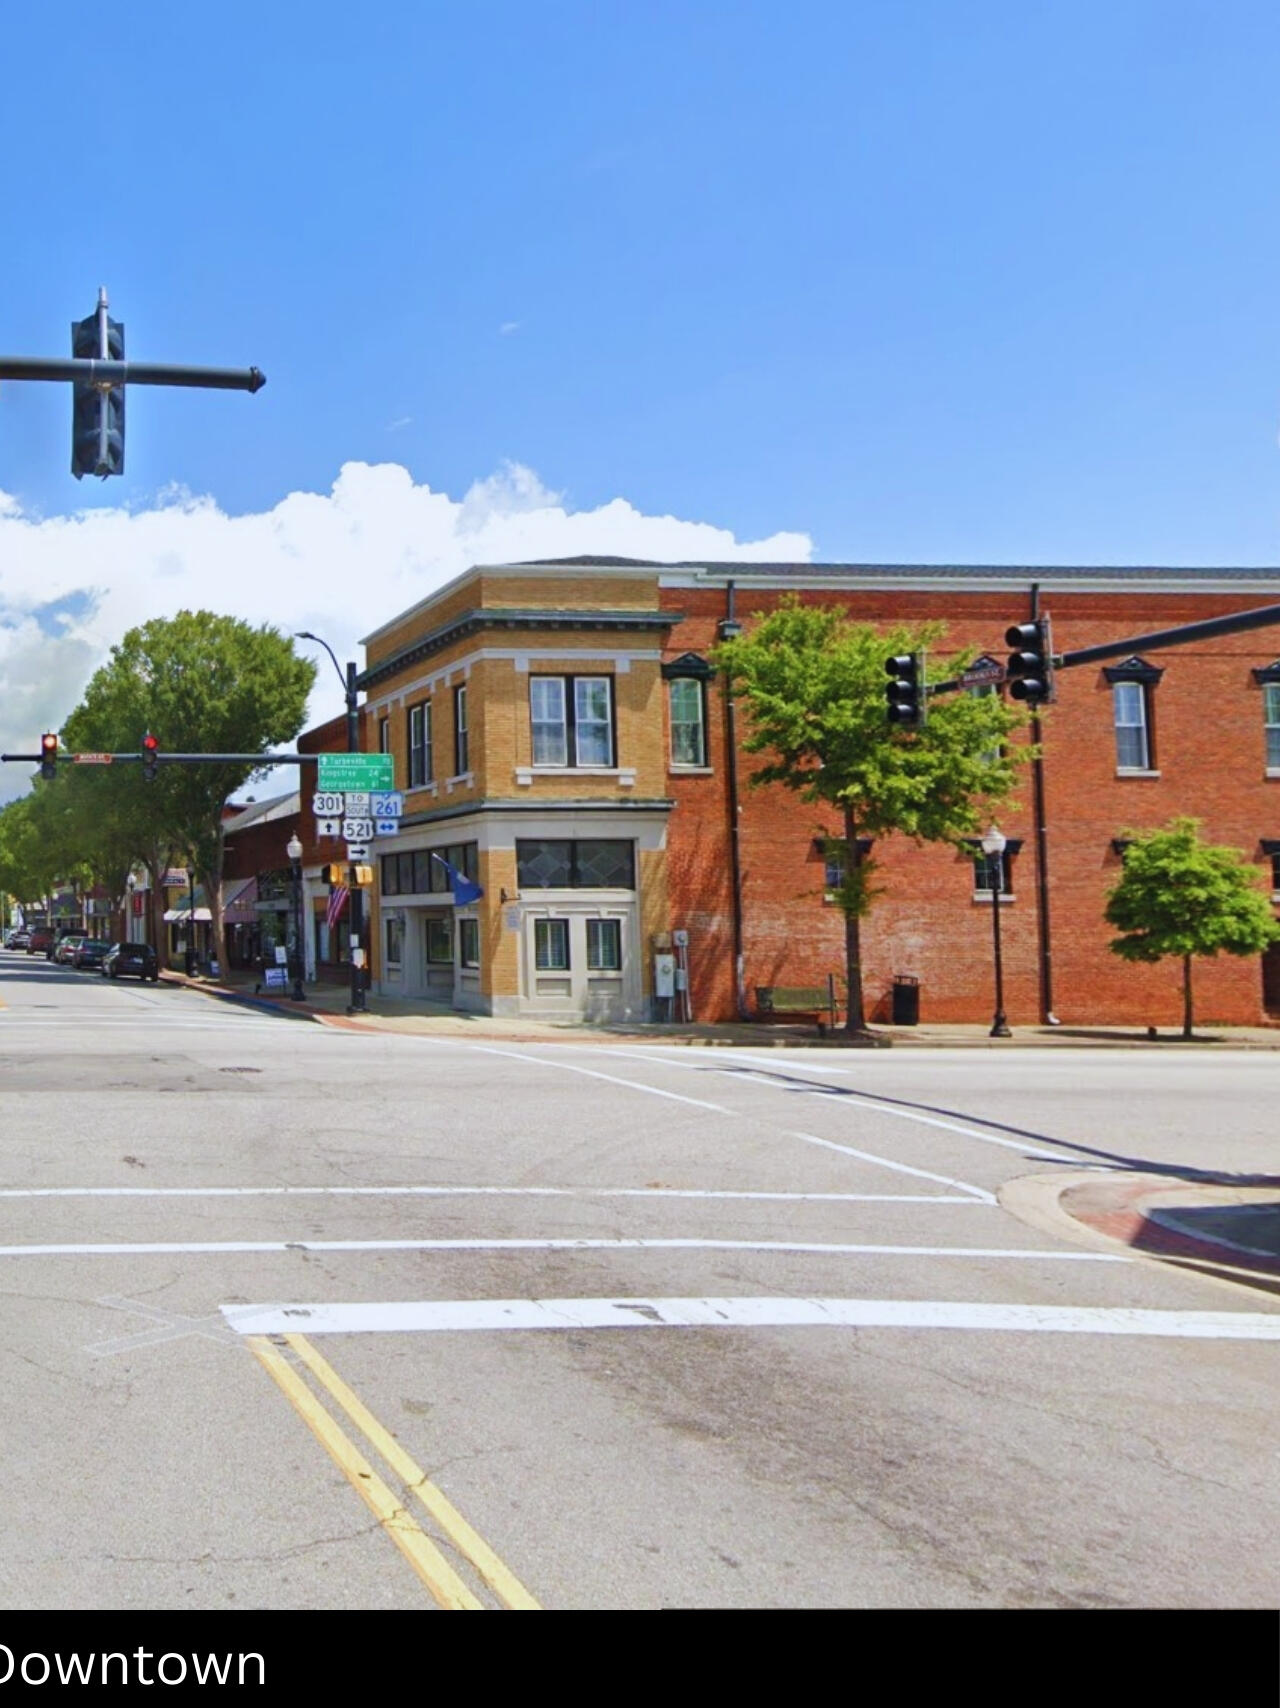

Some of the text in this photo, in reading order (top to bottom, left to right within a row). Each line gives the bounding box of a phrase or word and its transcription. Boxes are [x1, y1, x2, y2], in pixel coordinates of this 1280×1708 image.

[317, 796, 339, 811] 301
[376, 801, 398, 815] 261
[346, 823, 370, 838] 521
